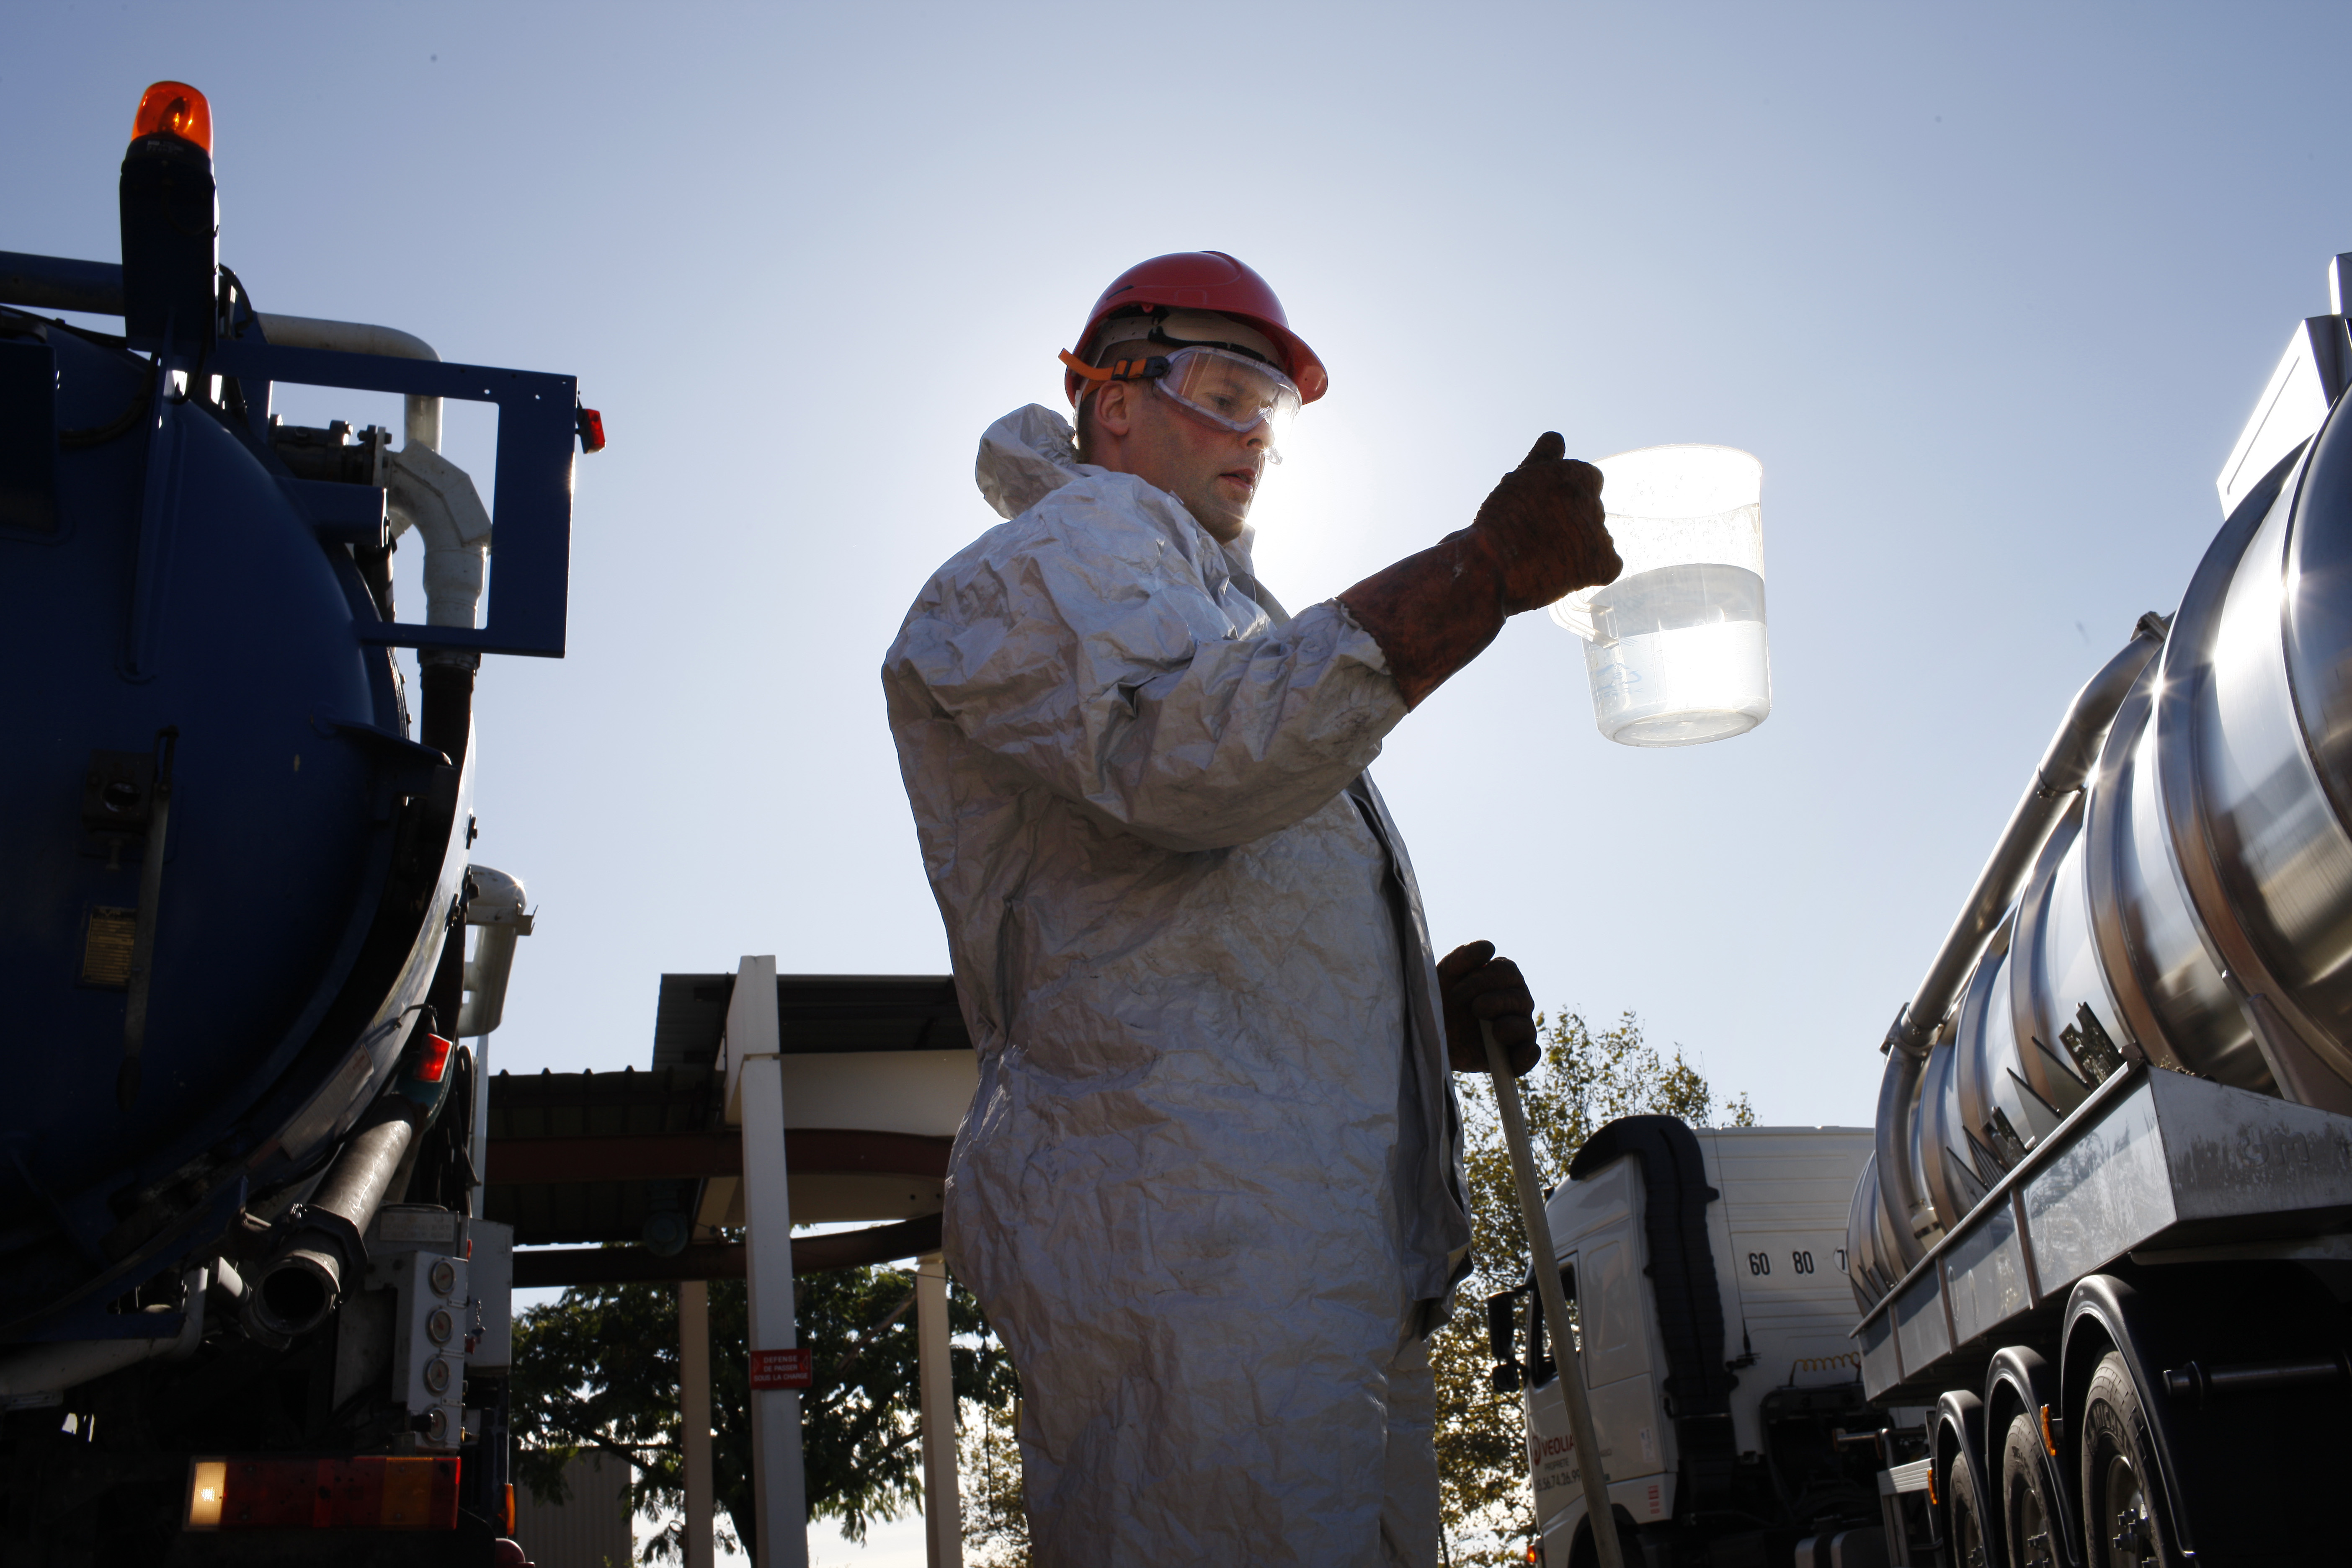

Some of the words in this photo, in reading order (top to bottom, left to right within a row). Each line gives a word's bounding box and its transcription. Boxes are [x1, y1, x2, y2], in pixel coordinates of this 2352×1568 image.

[1749, 1252, 1770, 1275] 60
[1792, 1251, 1814, 1274] 80
[1837, 1249, 1847, 1270] 7
[1541, 1434, 1574, 1457] VEOLIA
